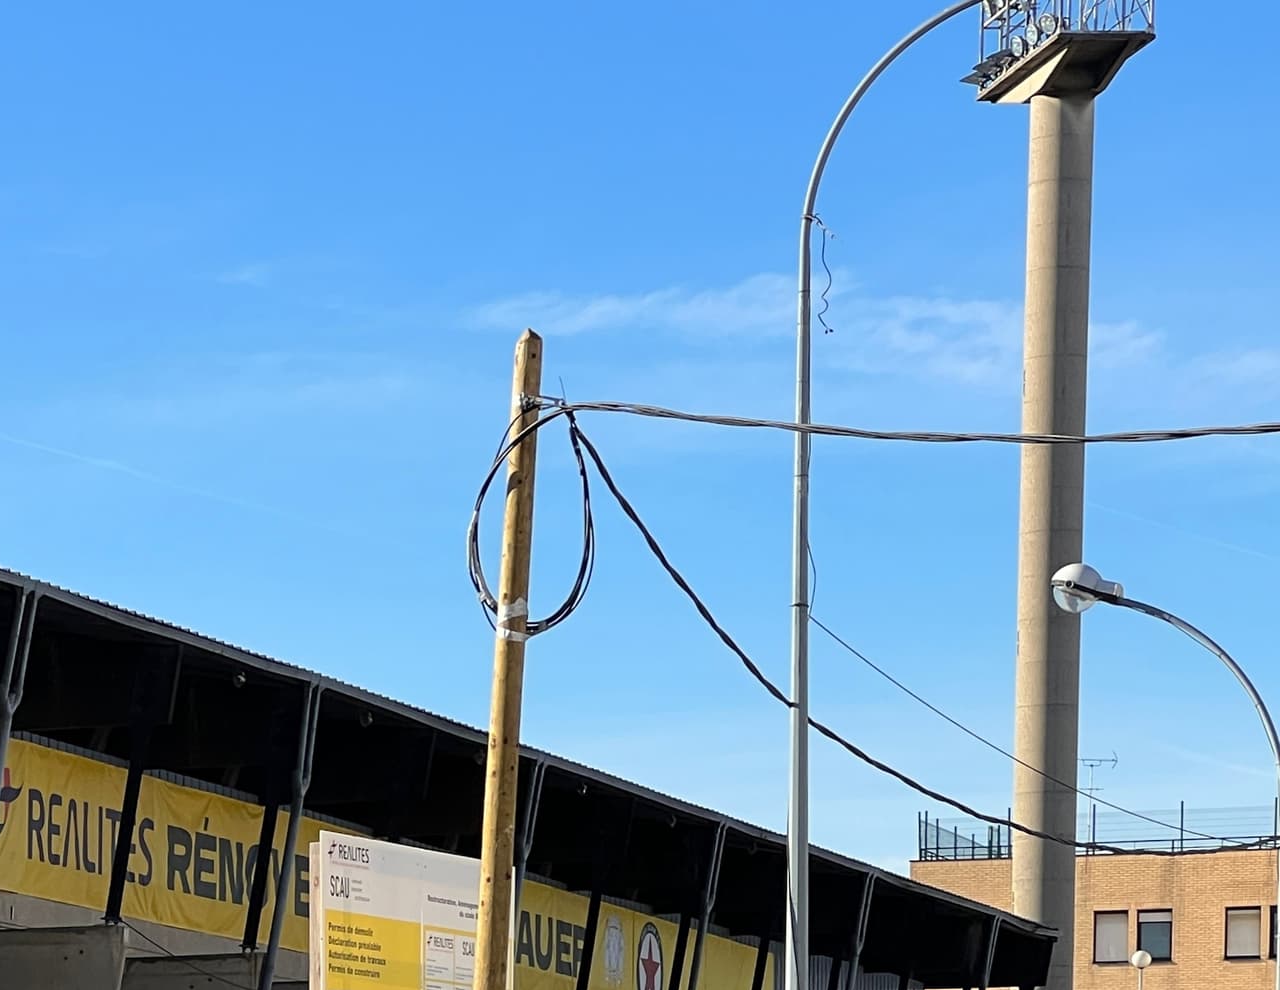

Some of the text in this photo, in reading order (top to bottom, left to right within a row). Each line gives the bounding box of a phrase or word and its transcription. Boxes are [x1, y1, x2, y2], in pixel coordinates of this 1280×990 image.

[338, 844, 370, 864] REALITES
[330, 875, 350, 899] SCAU
[328, 922, 346, 933] Permis
[347, 926, 353, 934] de
[515, 910, 587, 978] AUER
[328, 963, 346, 974] Permis
